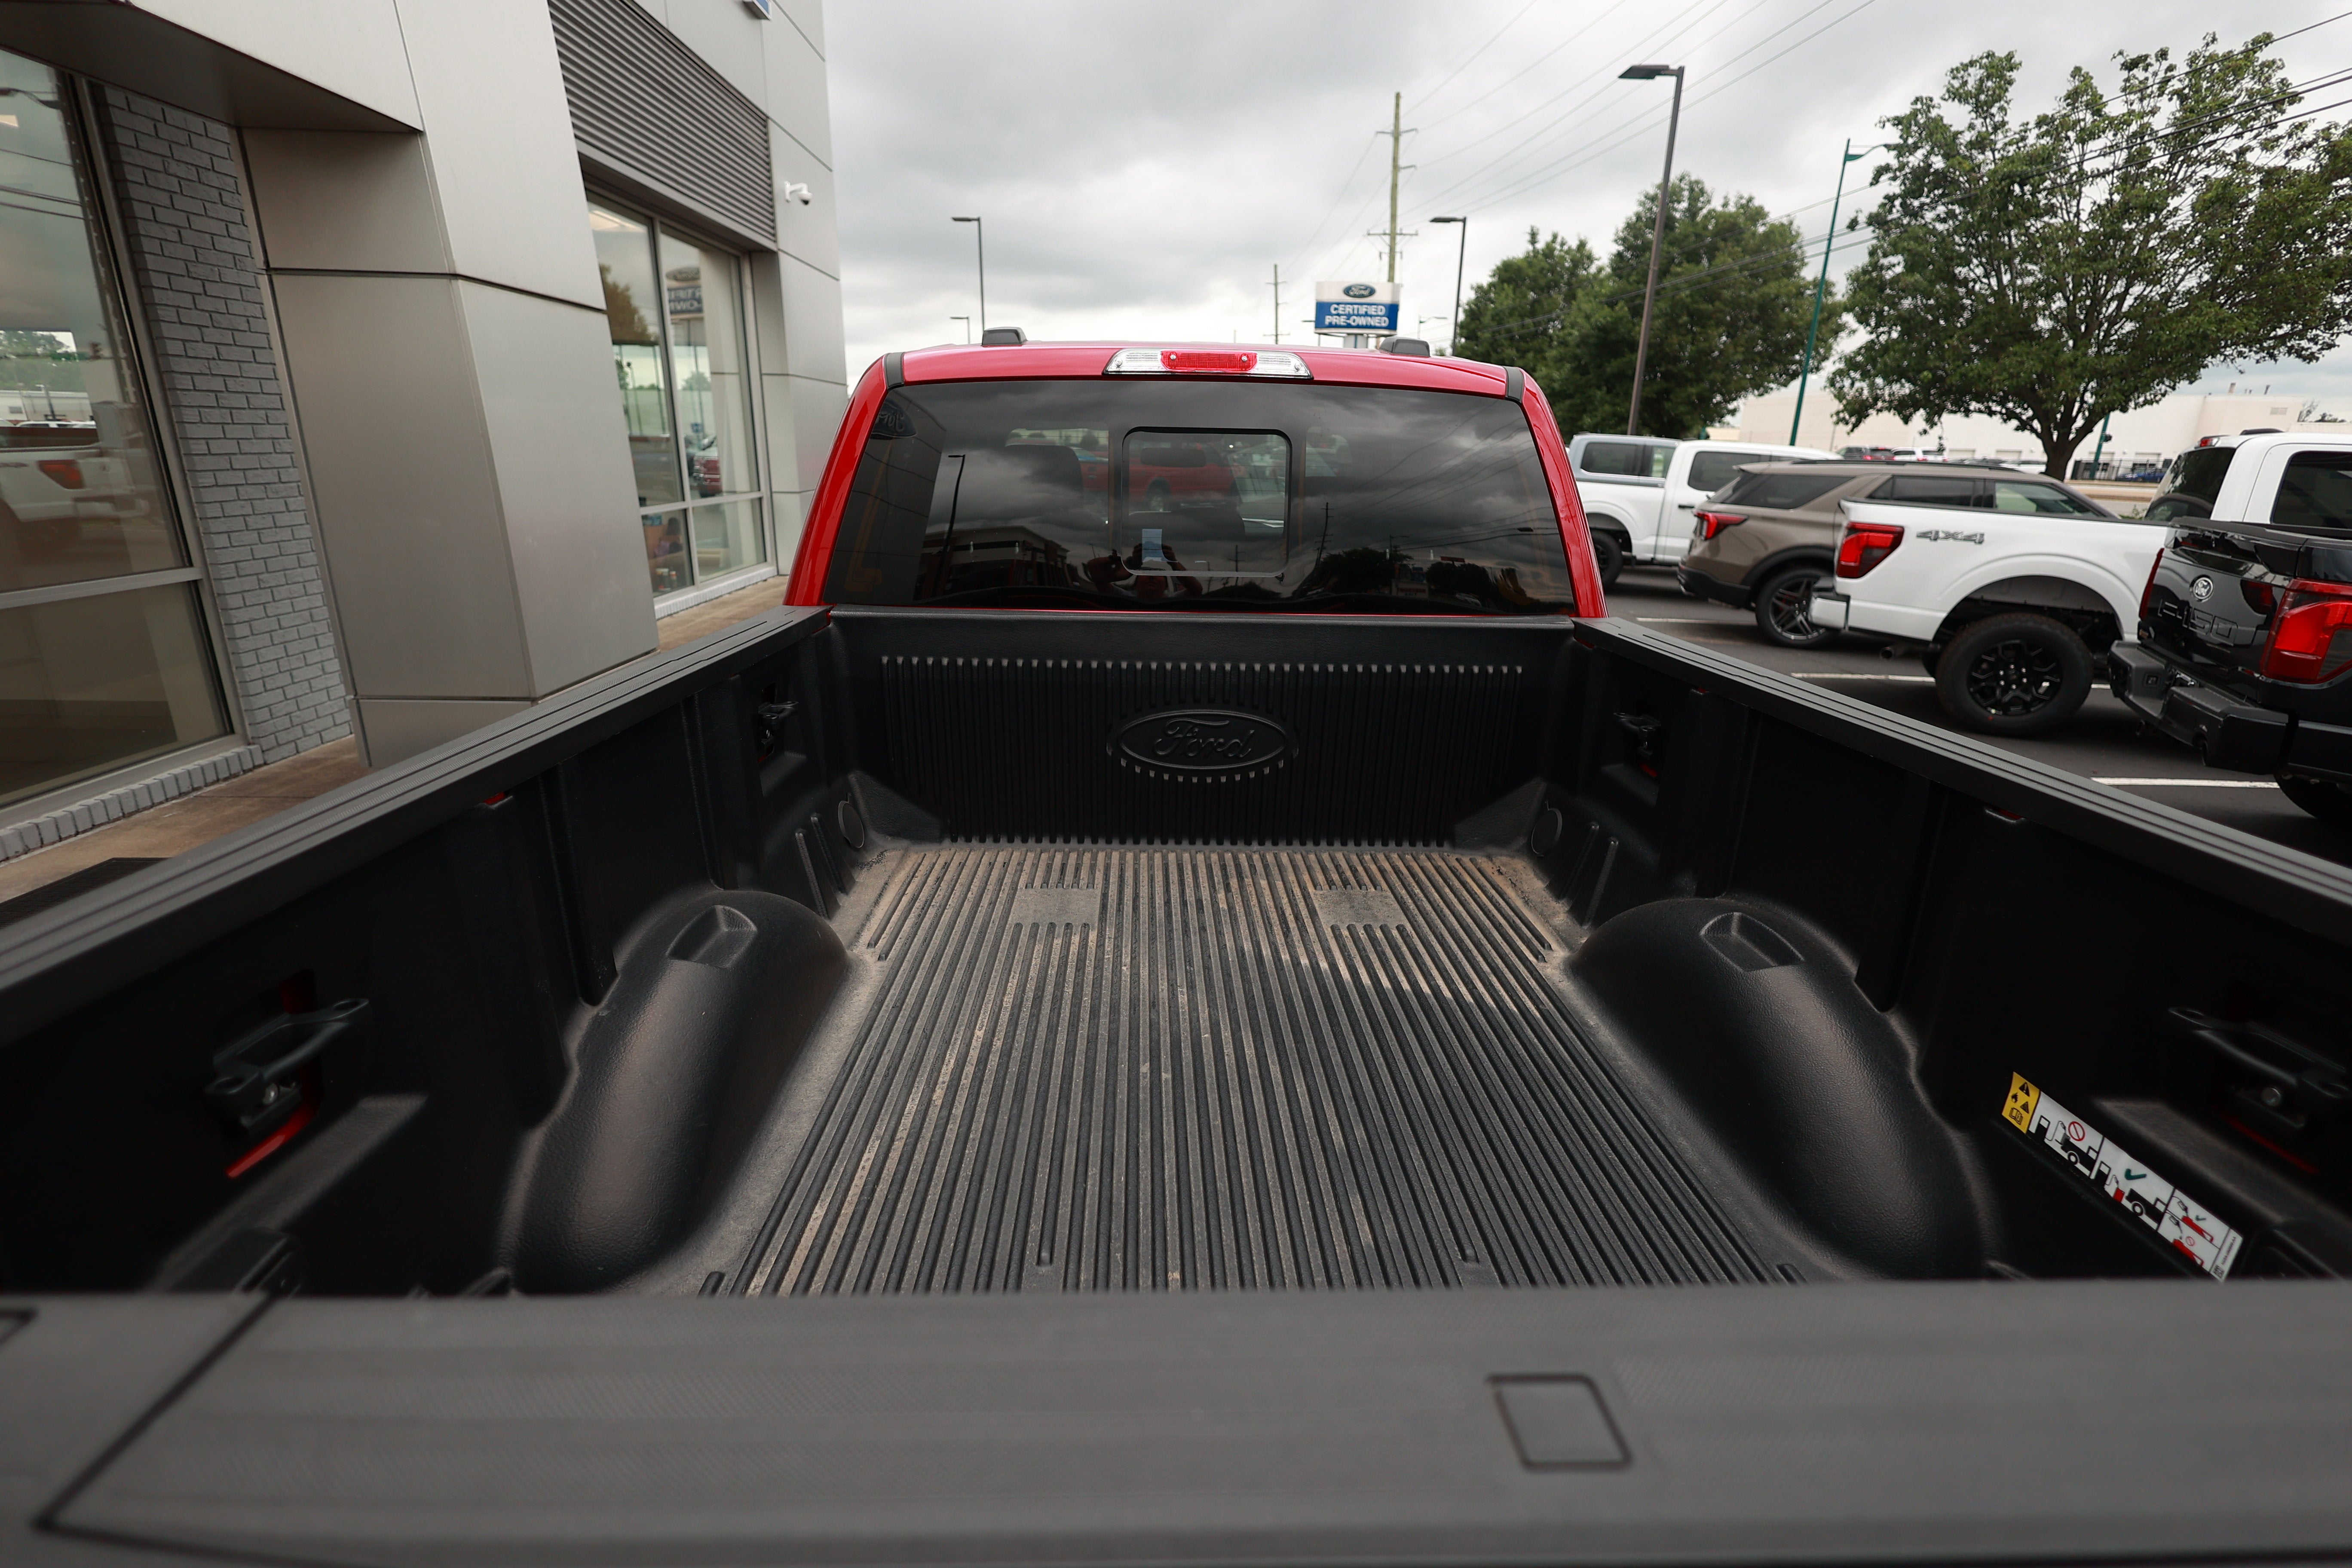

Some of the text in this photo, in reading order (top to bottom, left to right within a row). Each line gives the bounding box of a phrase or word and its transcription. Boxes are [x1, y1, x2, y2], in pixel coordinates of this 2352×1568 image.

[1349, 285, 1371, 295] Ford
[1330, 303, 1386, 315] CERTIFIED
[1325, 315, 1389, 327] PRE-OWNED
[2157, 598, 2238, 647] F-150
[1153, 717, 1255, 760] Ford
